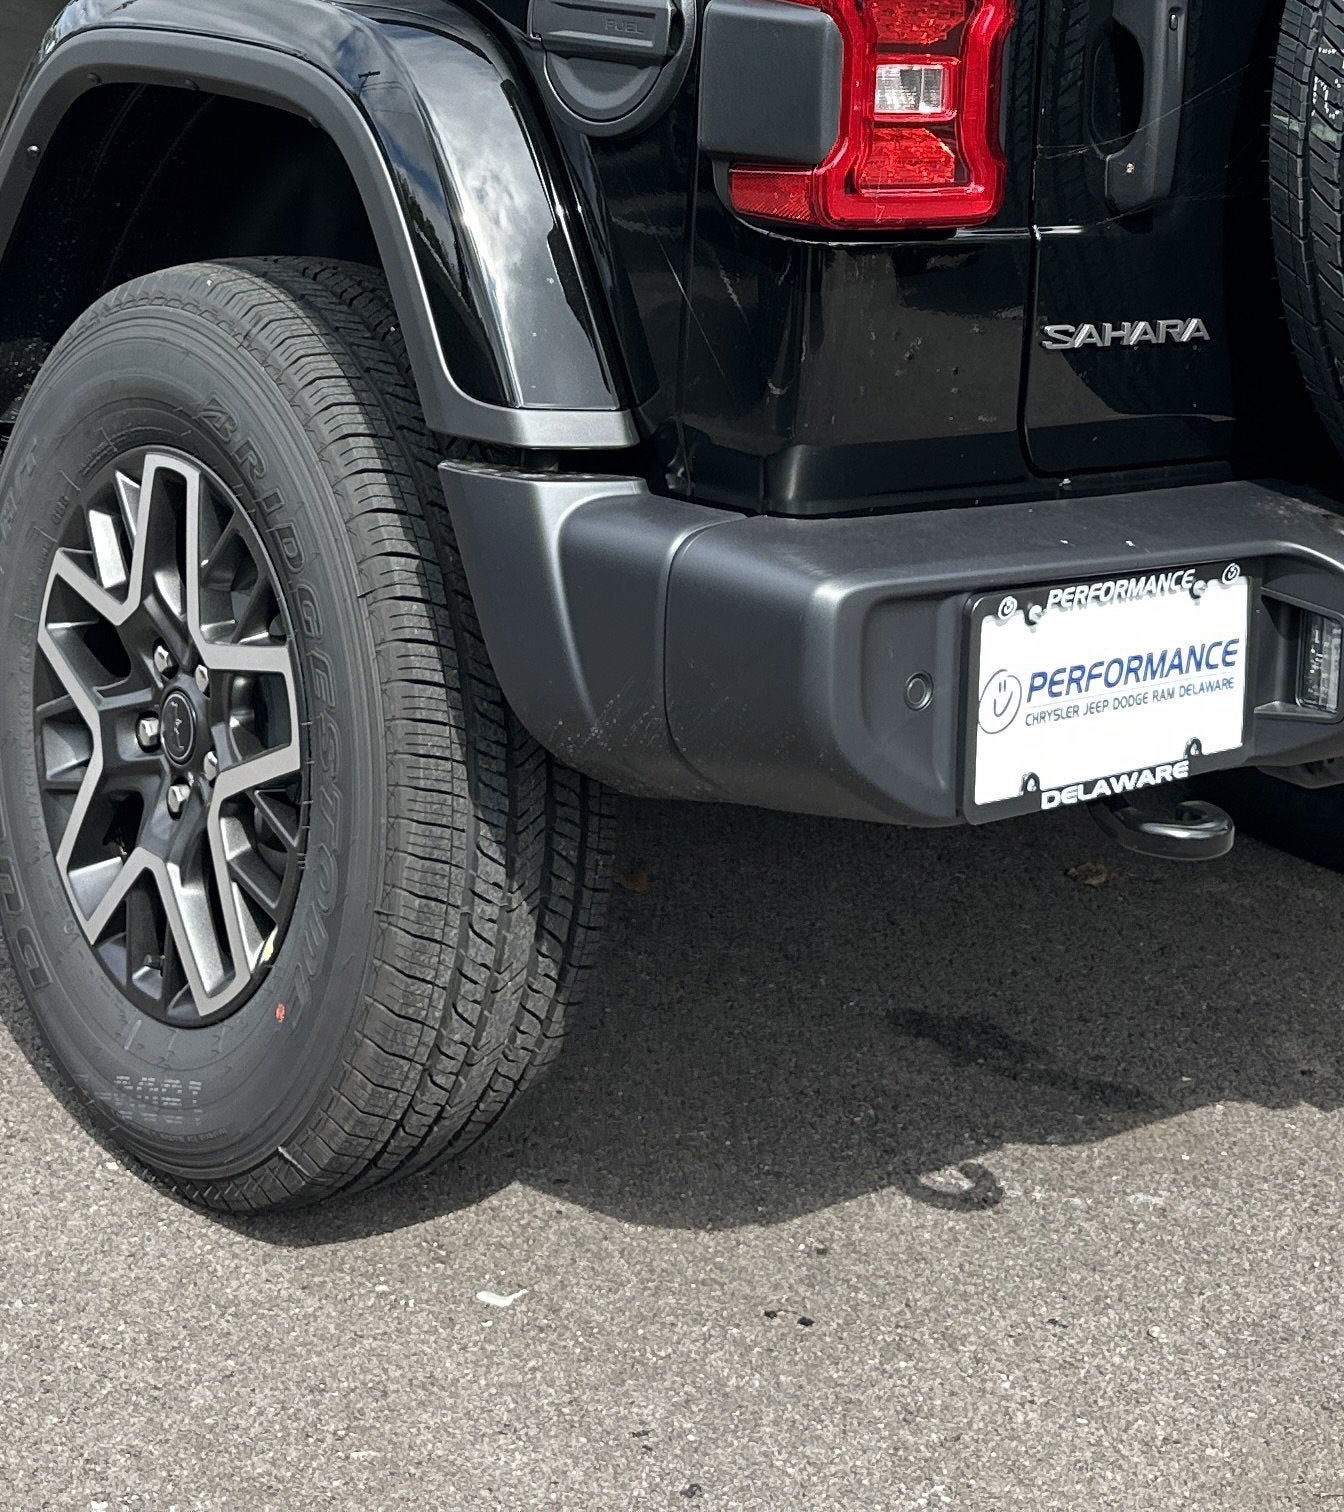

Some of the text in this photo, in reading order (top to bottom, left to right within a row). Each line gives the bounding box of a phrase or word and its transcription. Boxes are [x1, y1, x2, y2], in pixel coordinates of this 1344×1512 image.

[604, 19, 644, 34] FUEL
[1042, 318, 1210, 350] SAHARA
[1046, 569, 1196, 611] PERFORMANCE
[1026, 638, 1240, 703] PERFORMANCE
[198, 399, 341, 1030] BRIDGESTONE
[1025, 677, 1235, 727] CHRYSLER JEEP DODGE RAM DELAWARE
[1040, 760, 1190, 810] DELAWARE
